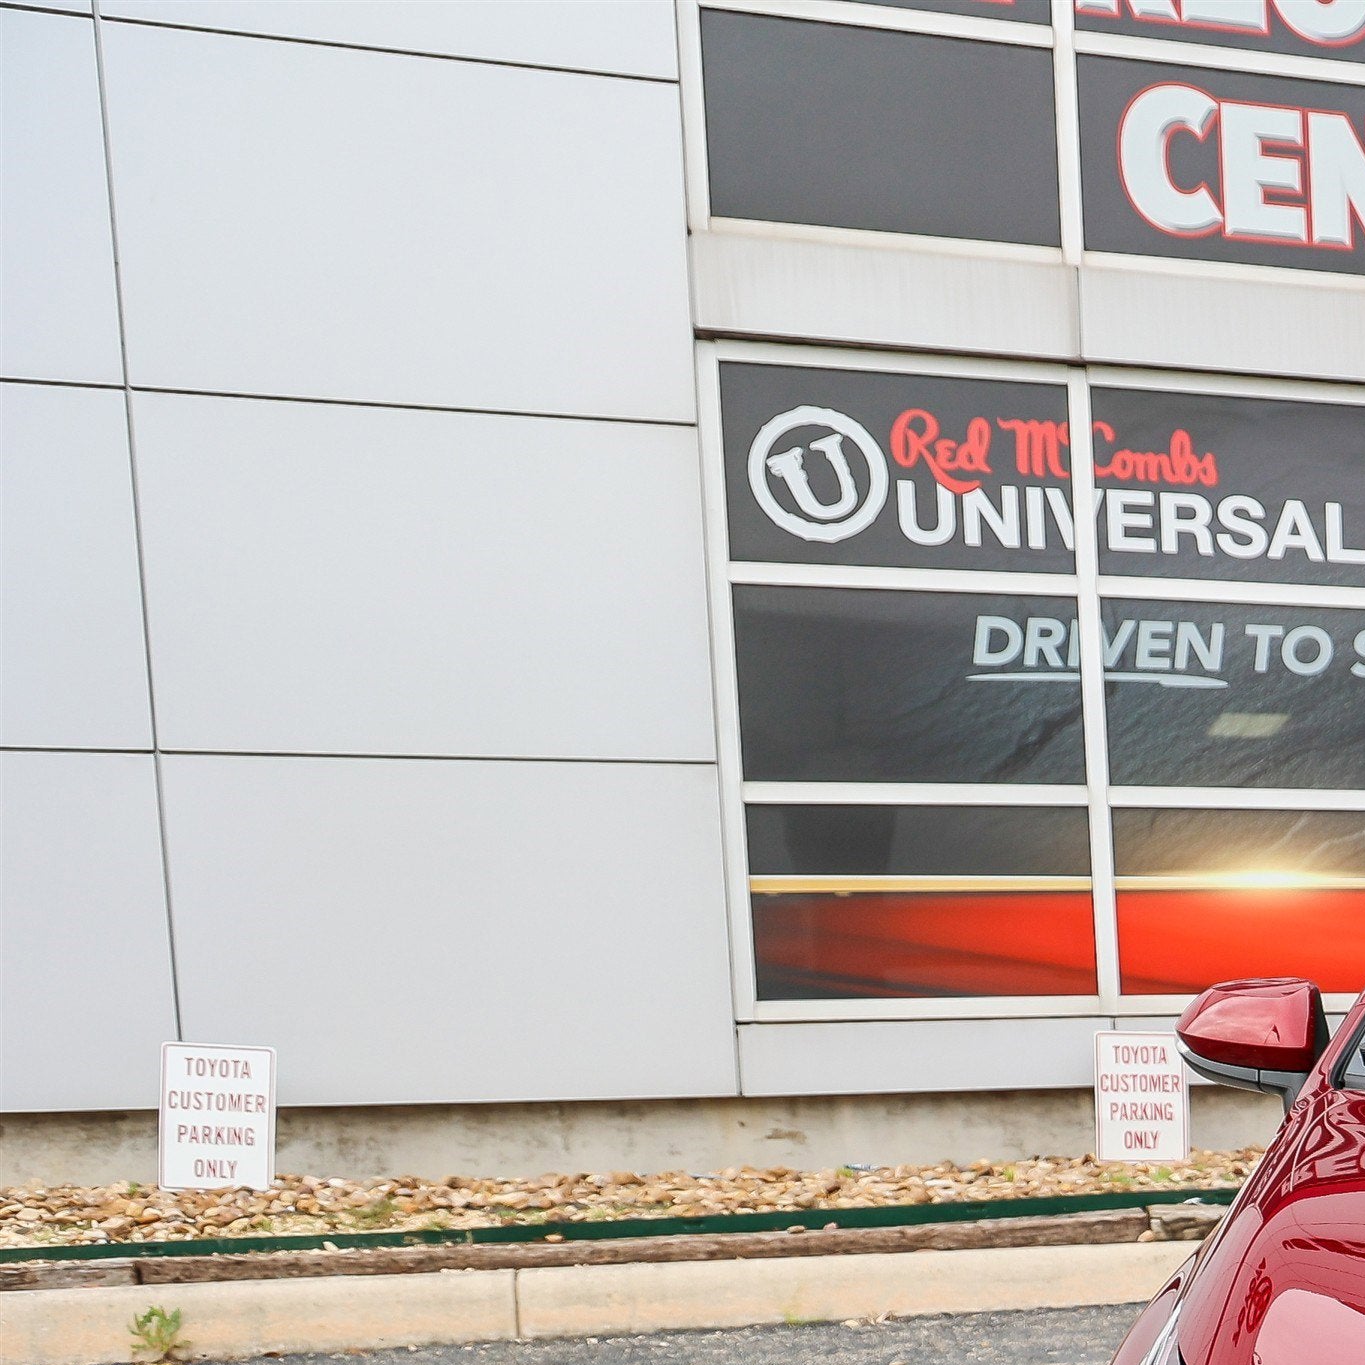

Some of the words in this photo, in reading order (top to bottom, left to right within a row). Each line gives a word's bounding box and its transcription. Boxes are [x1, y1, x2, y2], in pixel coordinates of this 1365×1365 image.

[890, 408, 993, 495] Red
[972, 615, 1226, 672] DRIVEN
[1245, 623, 1335, 677] TO
[1112, 1045, 1167, 1064] TOYOTA
[184, 1057, 253, 1079] TOYOTA
[1100, 1074, 1181, 1093] CUSTOMER
[168, 1090, 266, 1113] CUSTOMER
[1110, 1102, 1173, 1121] PARKING
[177, 1124, 256, 1146] PARKING
[1124, 1130, 1159, 1150] ONLY
[194, 1158, 238, 1179] ONLY
